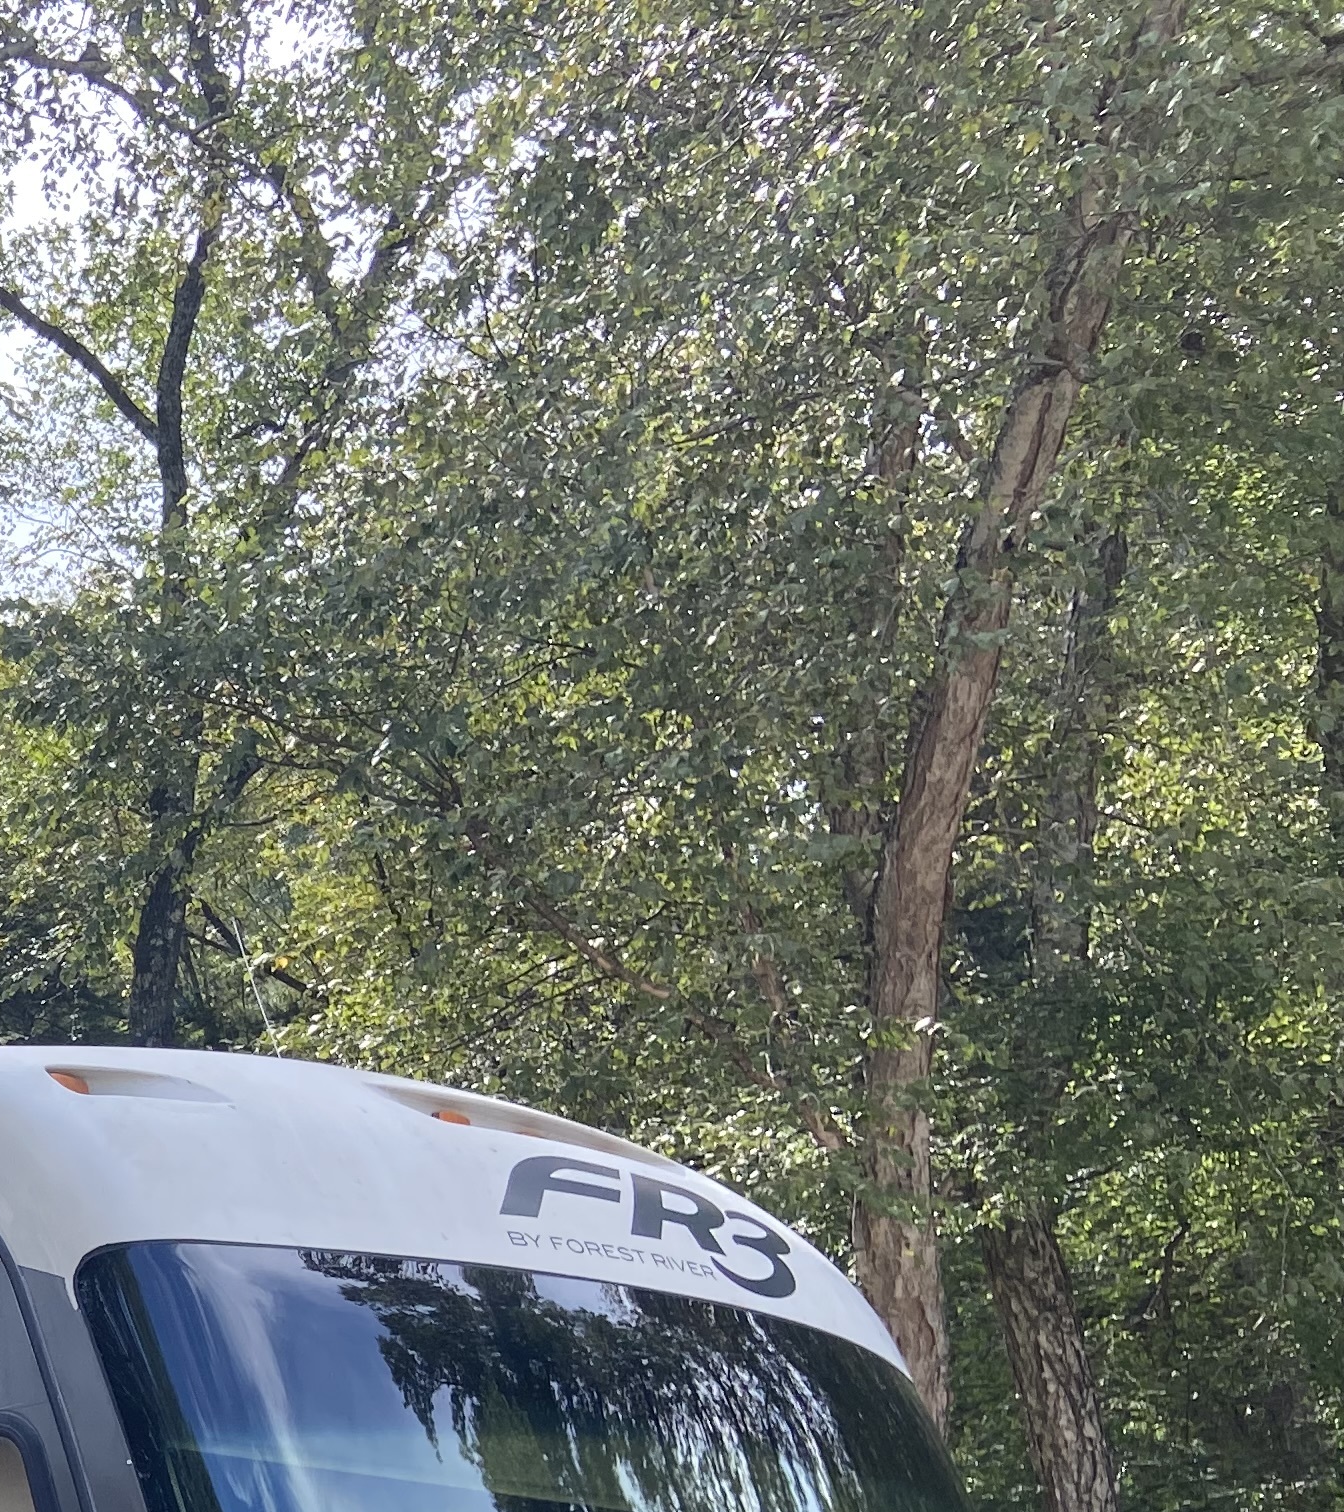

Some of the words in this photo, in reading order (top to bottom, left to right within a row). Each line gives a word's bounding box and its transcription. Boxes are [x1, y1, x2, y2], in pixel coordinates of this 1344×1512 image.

[499, 1155, 797, 1299] FR3
[507, 1230, 540, 1247] BY
[550, 1236, 645, 1264] FOREST
[652, 1252, 718, 1280] RIVER
